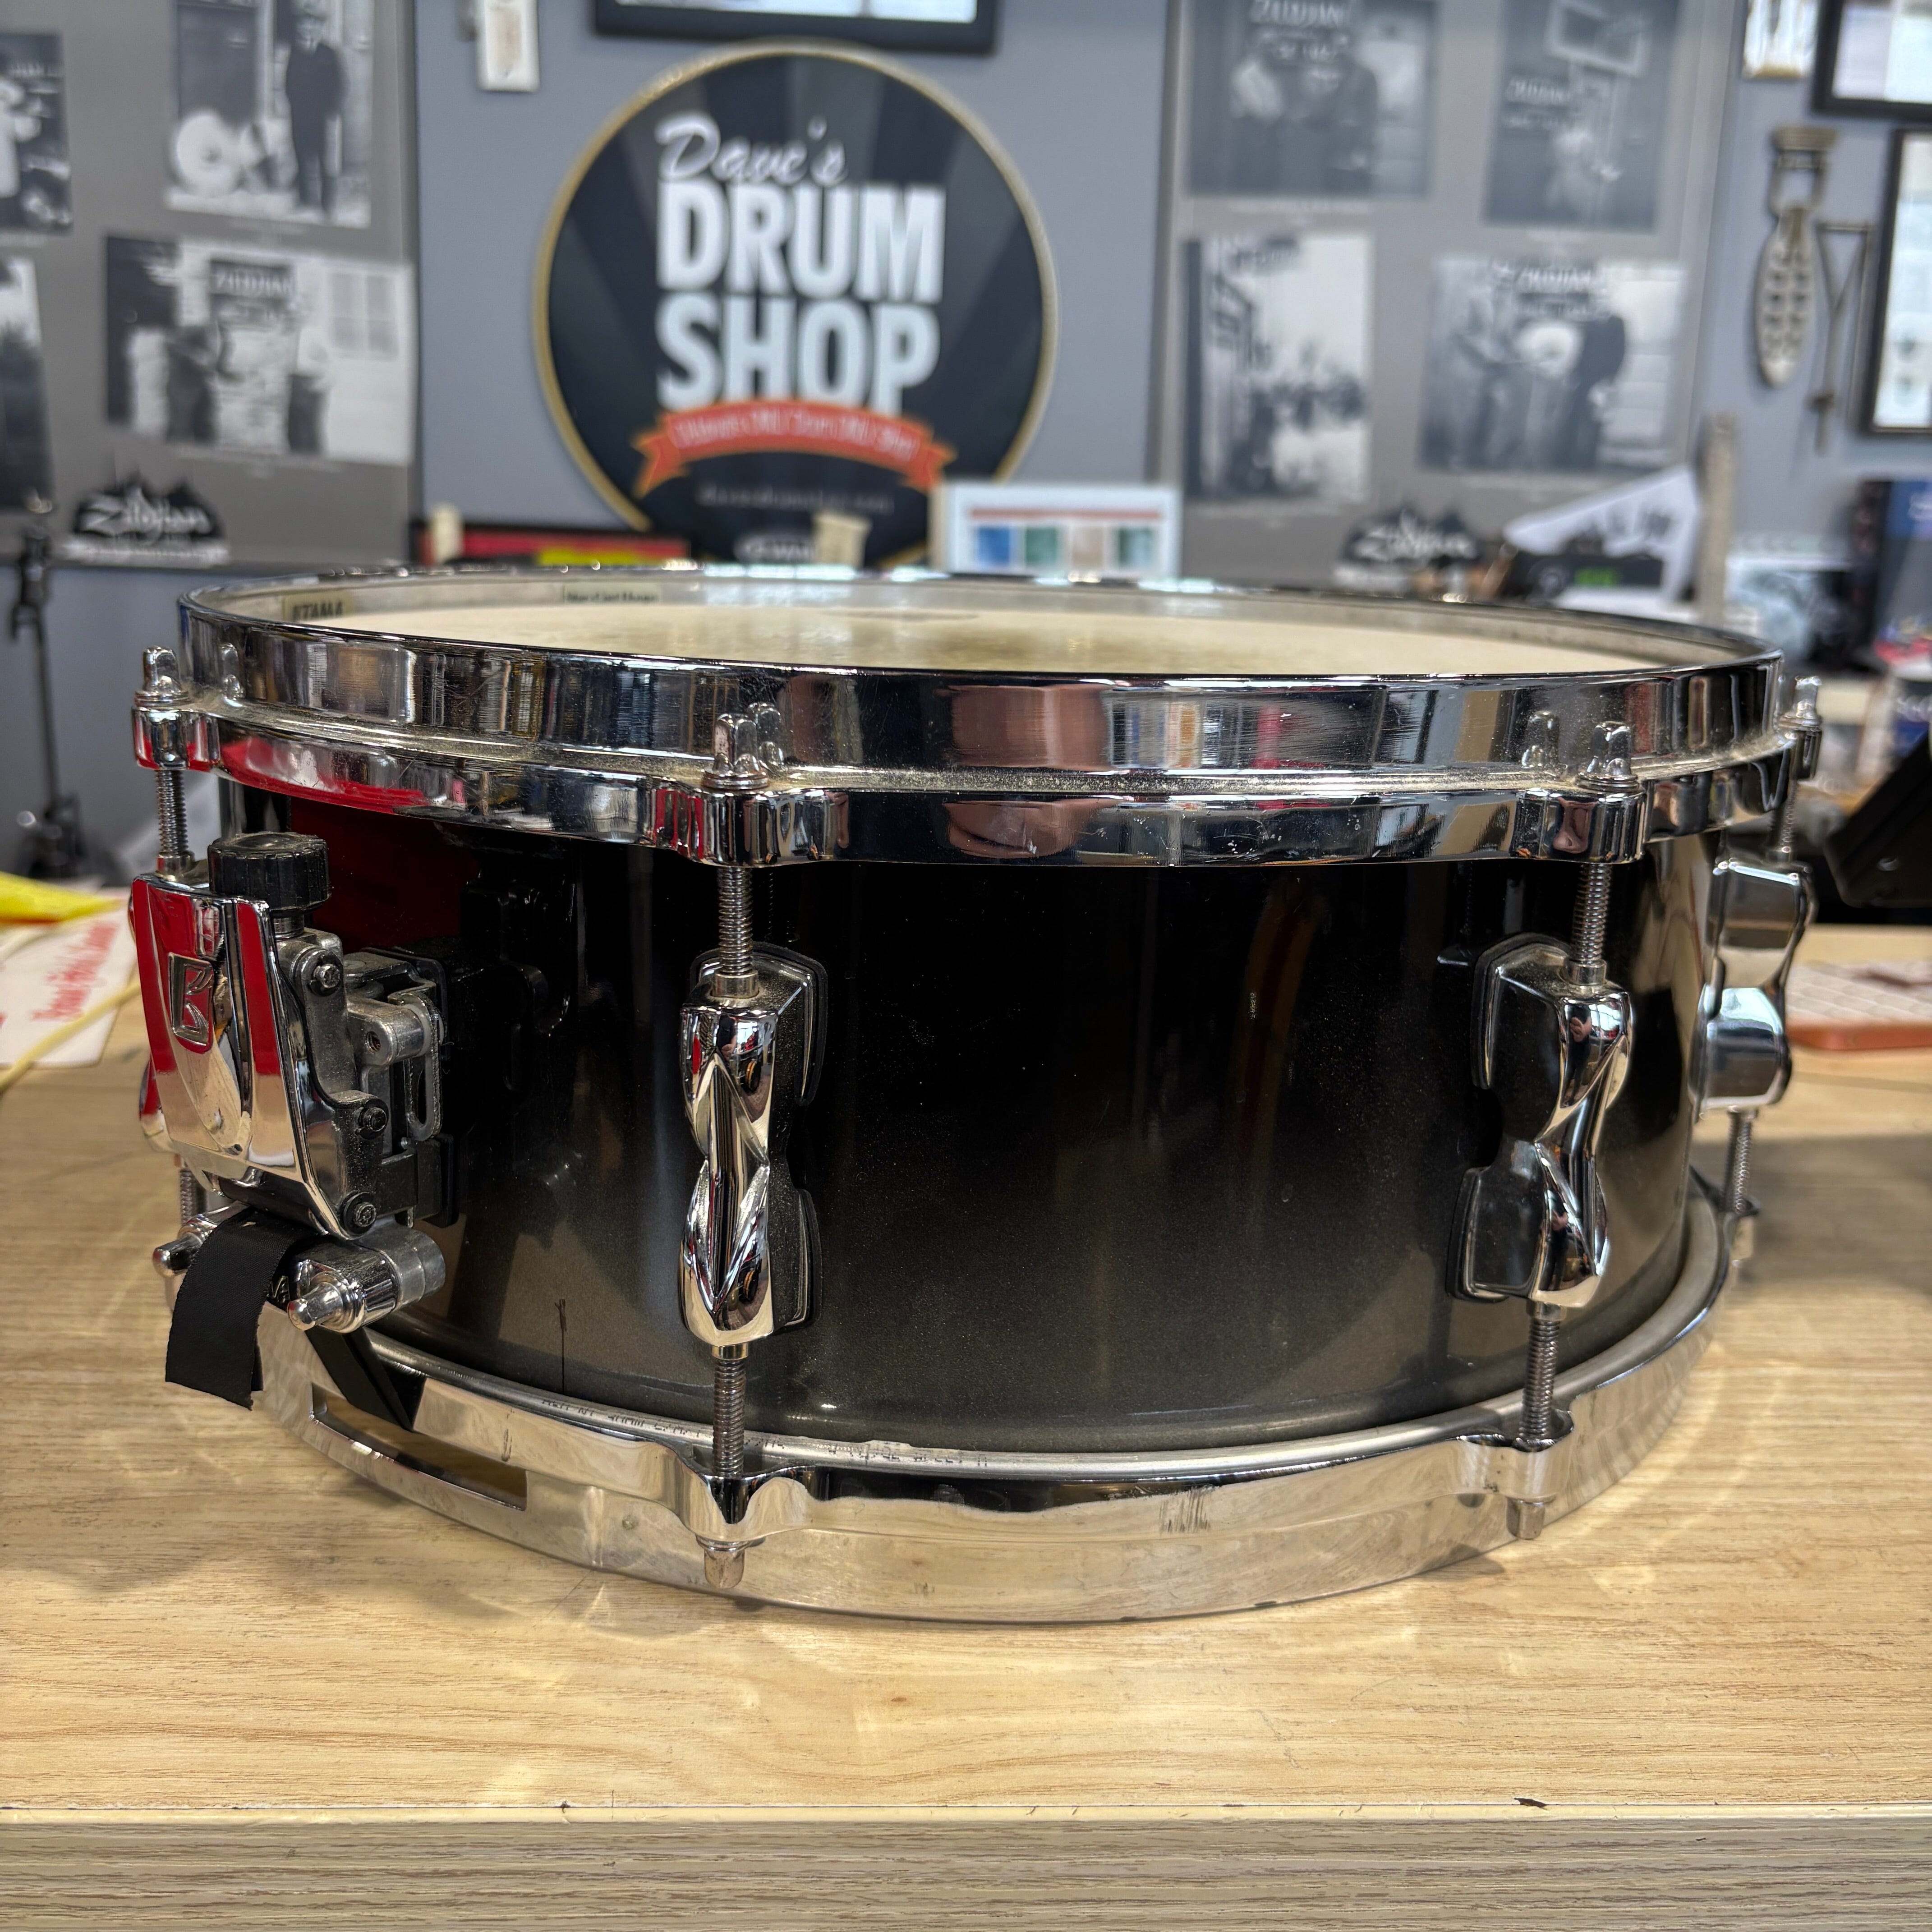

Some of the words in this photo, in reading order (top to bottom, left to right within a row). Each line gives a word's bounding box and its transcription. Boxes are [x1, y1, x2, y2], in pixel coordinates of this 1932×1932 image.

[656, 113, 846, 185] Dave's
[657, 181, 946, 303] DRUM
[655, 292, 940, 418] SHOP
